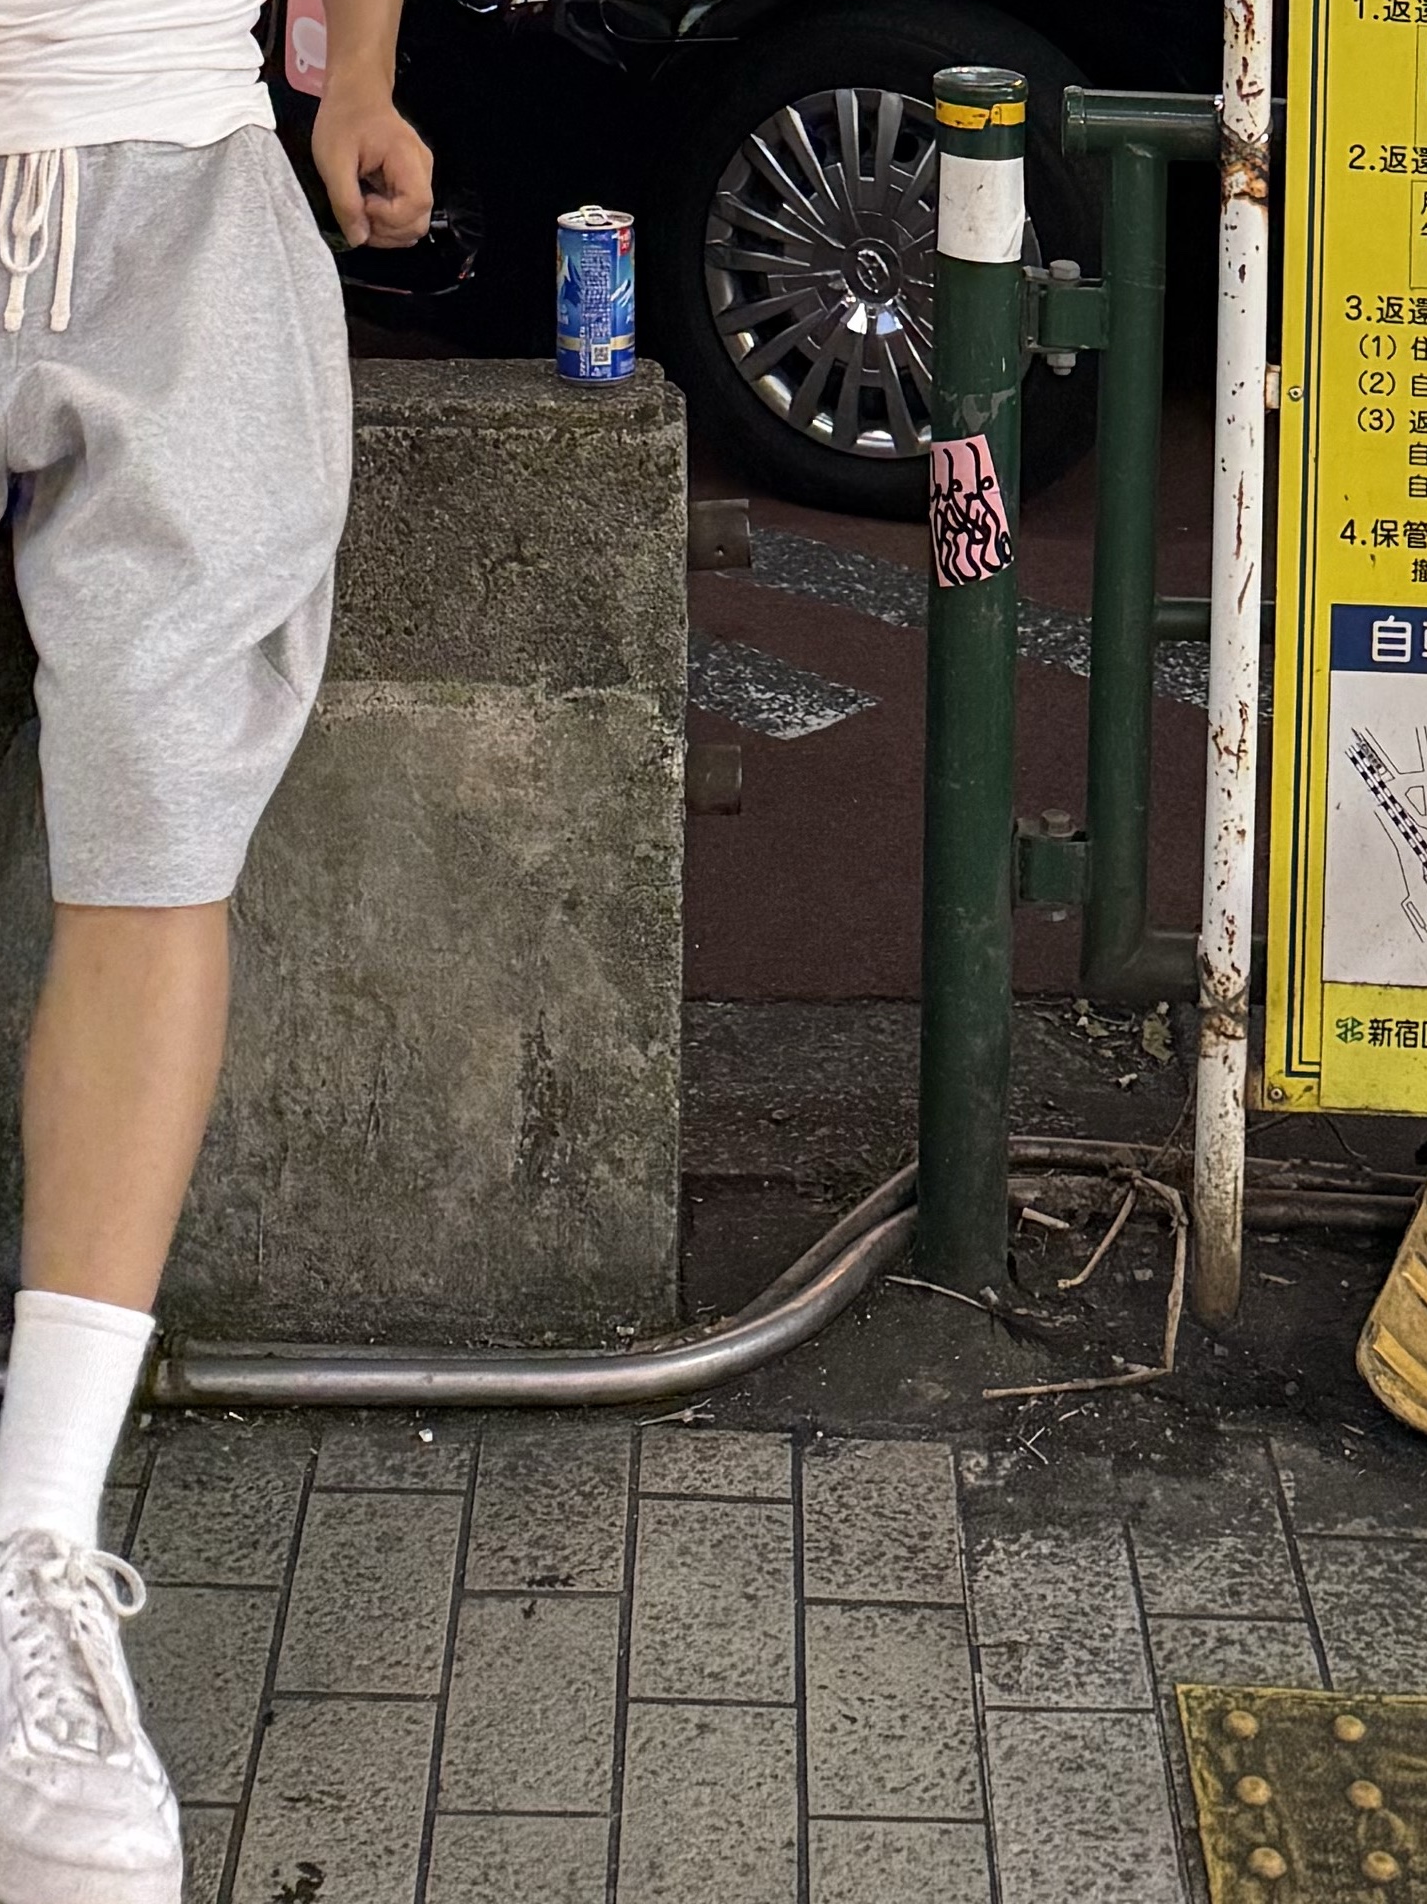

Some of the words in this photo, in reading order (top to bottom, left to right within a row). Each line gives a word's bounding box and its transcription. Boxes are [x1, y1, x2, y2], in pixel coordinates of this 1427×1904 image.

[1358, 334, 1398, 361] (1)
[1357, 371, 1397, 398] (2)
[1356, 407, 1396, 434] (3)
